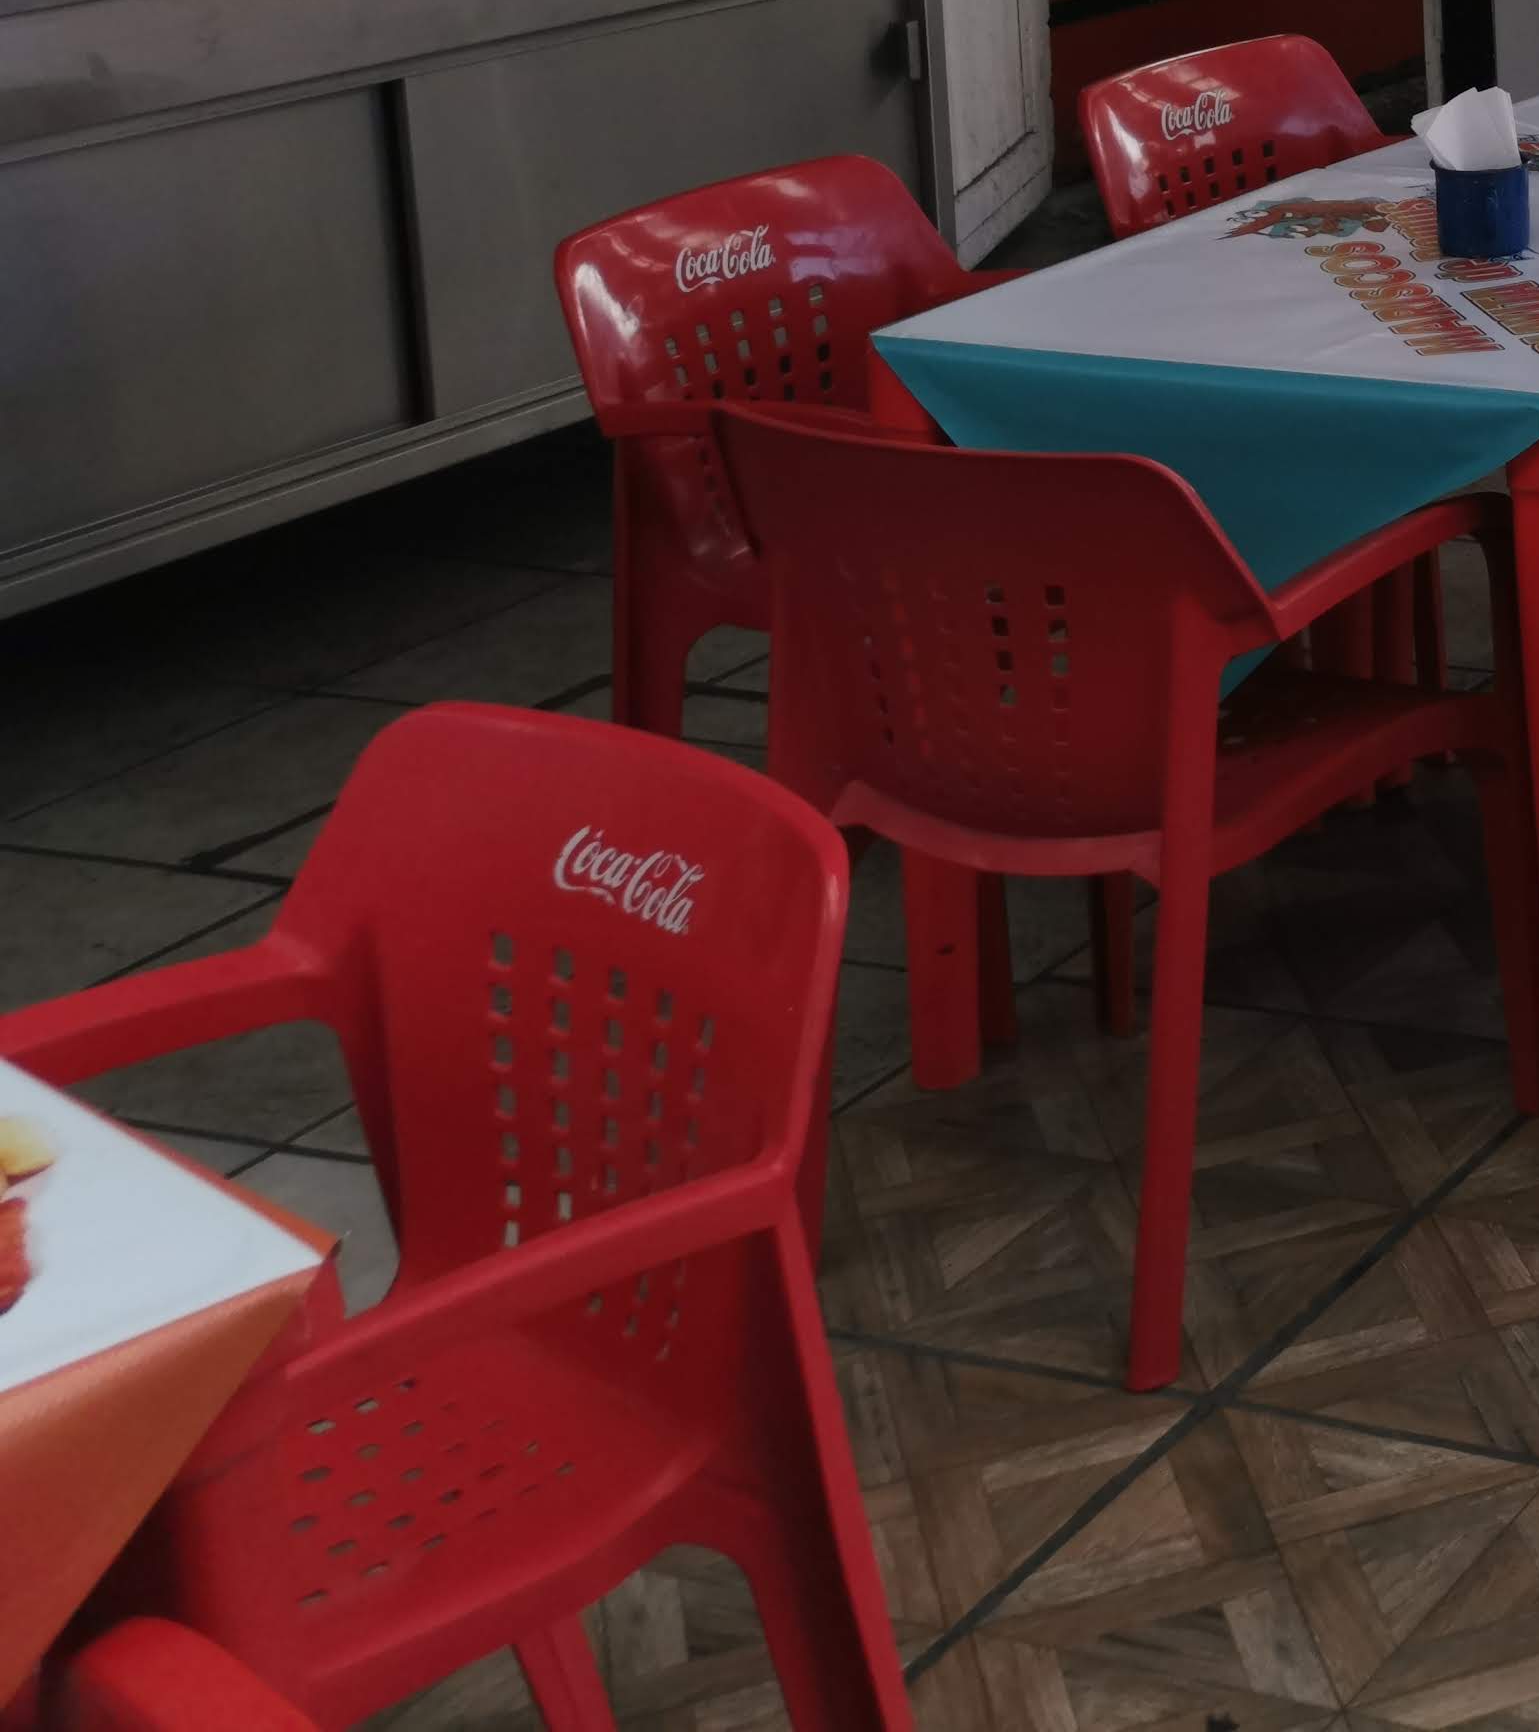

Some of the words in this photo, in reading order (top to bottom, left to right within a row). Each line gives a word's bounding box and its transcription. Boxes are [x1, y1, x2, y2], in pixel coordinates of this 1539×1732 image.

[1160, 87, 1235, 139] Coca-Cola
[676, 223, 777, 294] Coca-Cola
[1304, 240, 1506, 358] MARISCOS
[554, 822, 706, 938] Coca-Cola
